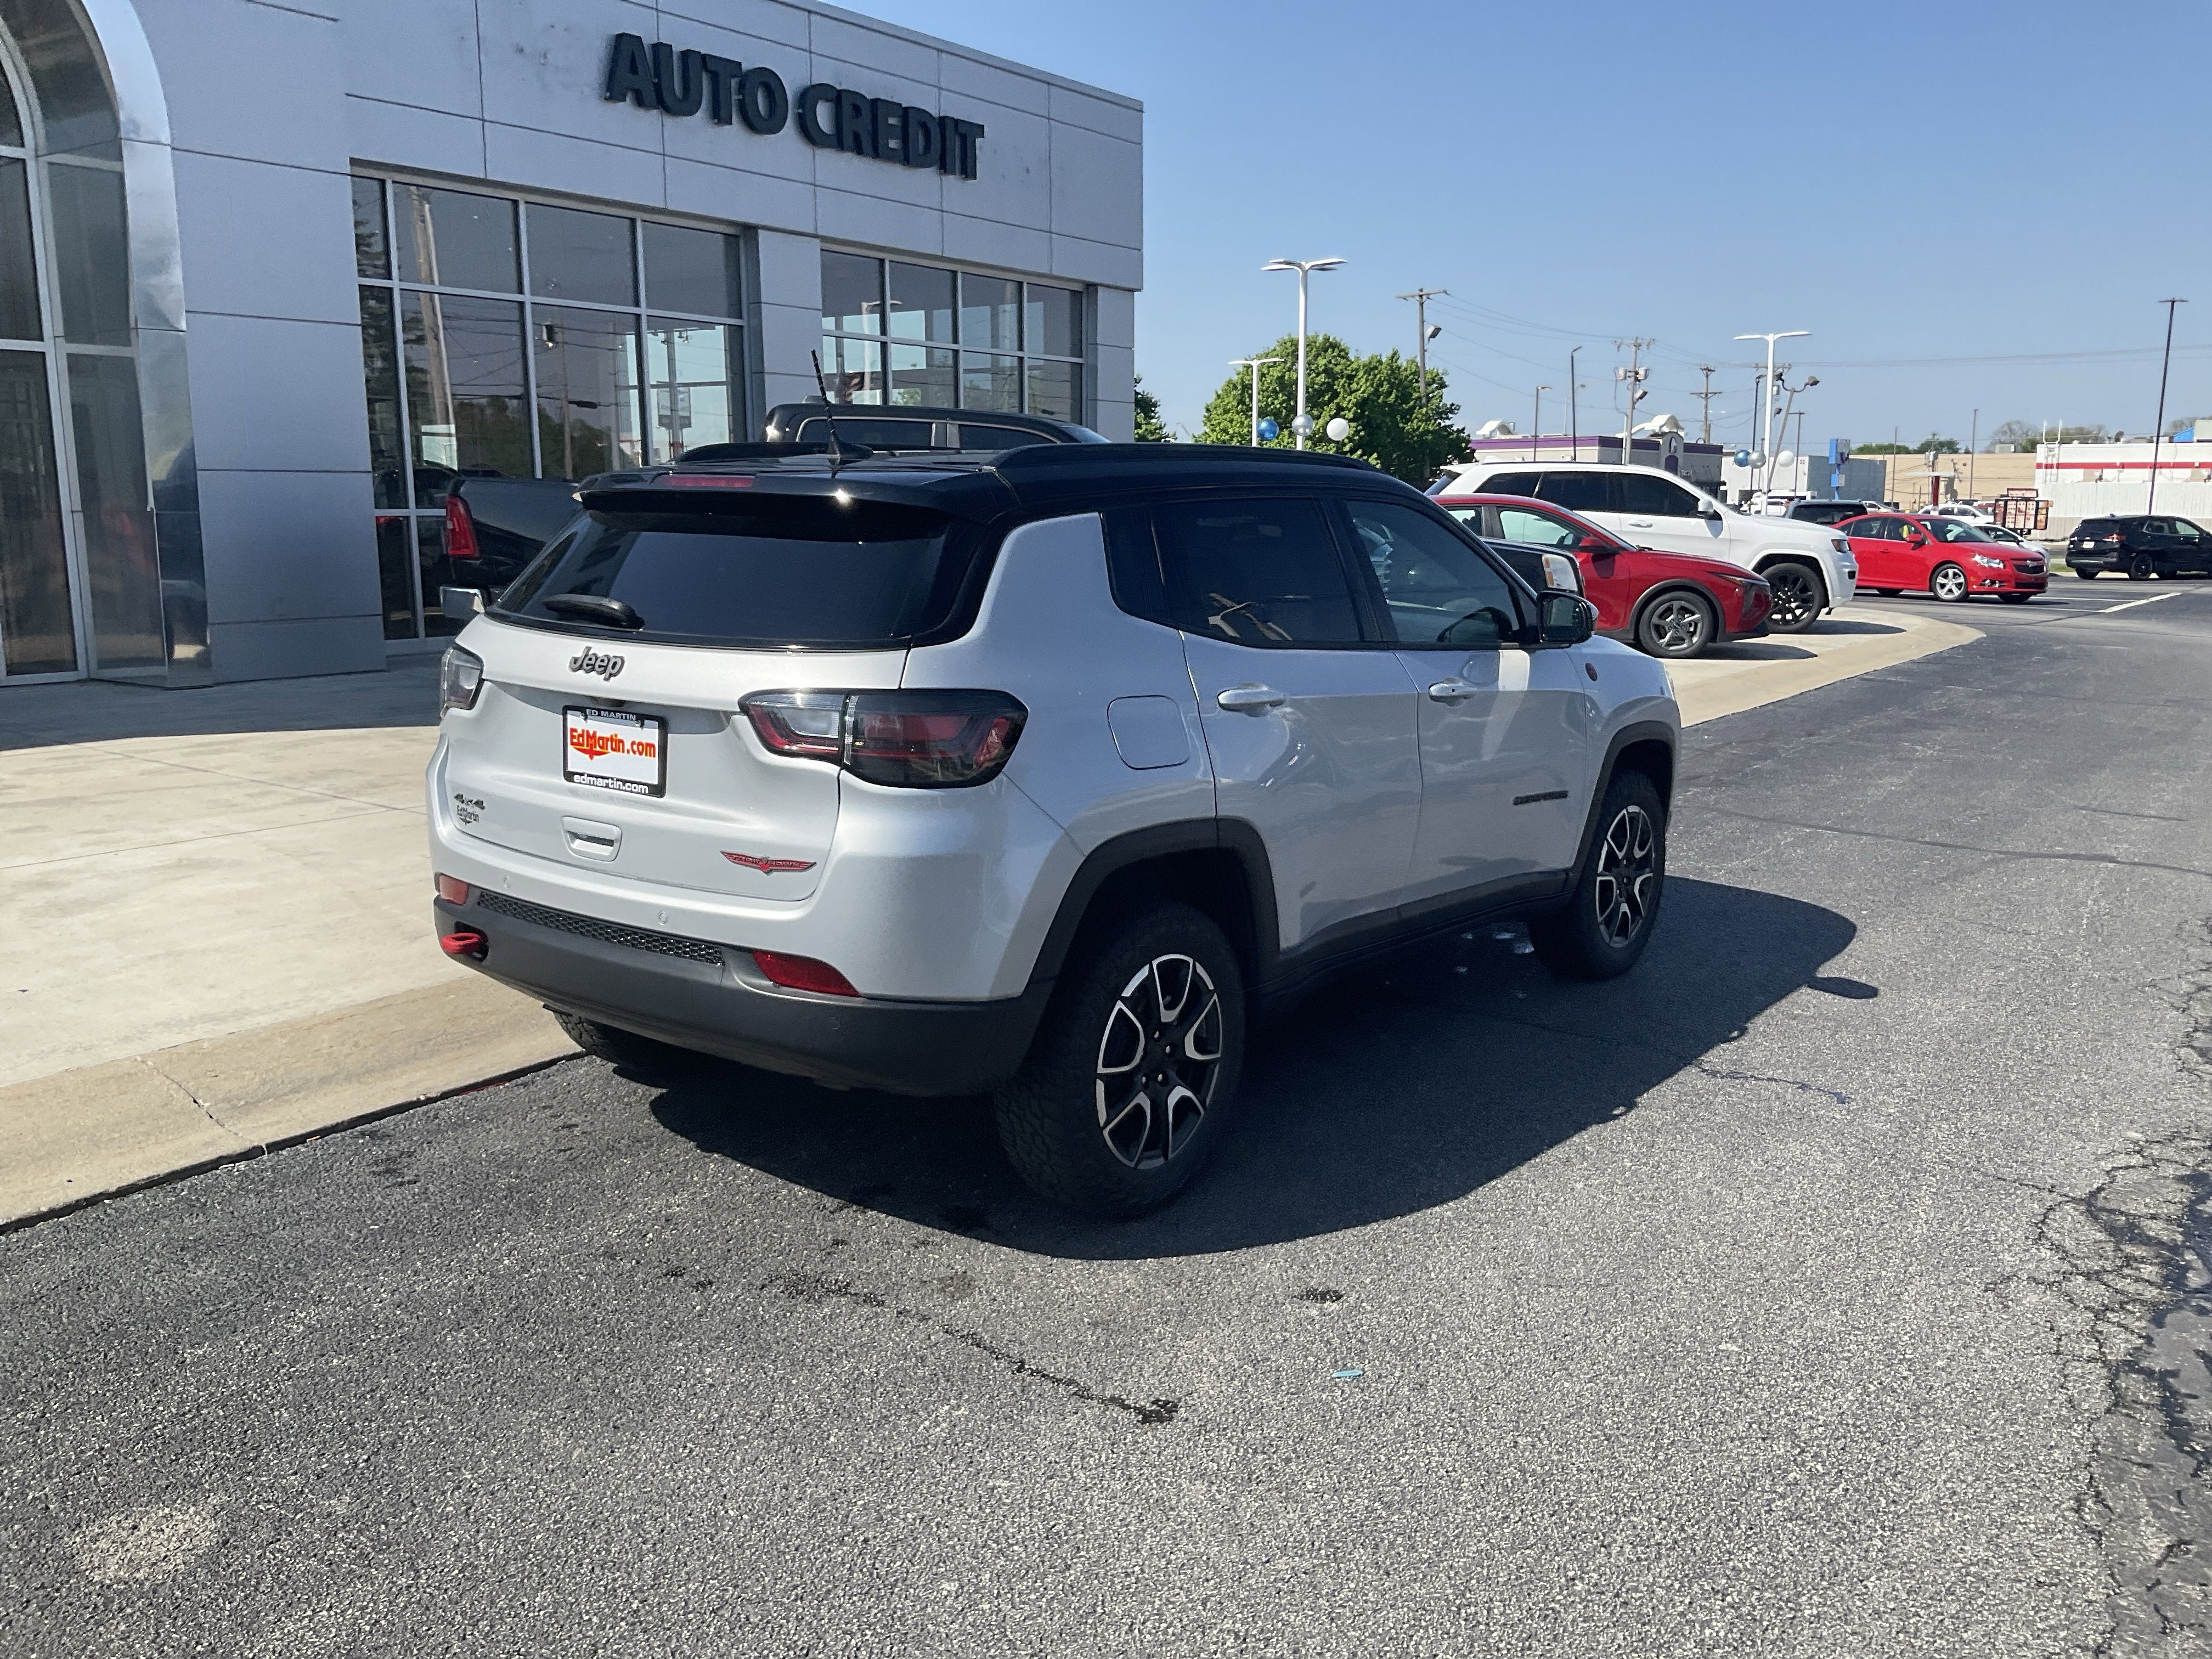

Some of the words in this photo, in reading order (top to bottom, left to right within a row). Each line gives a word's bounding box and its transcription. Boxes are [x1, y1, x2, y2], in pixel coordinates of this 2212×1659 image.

[603, 32, 788, 135] AUTO
[797, 83, 985, 180] CREDIT
[569, 646, 625, 681] Jeep
[600, 710, 636, 721] MARTIN
[574, 773, 648, 794] edmartin.com
